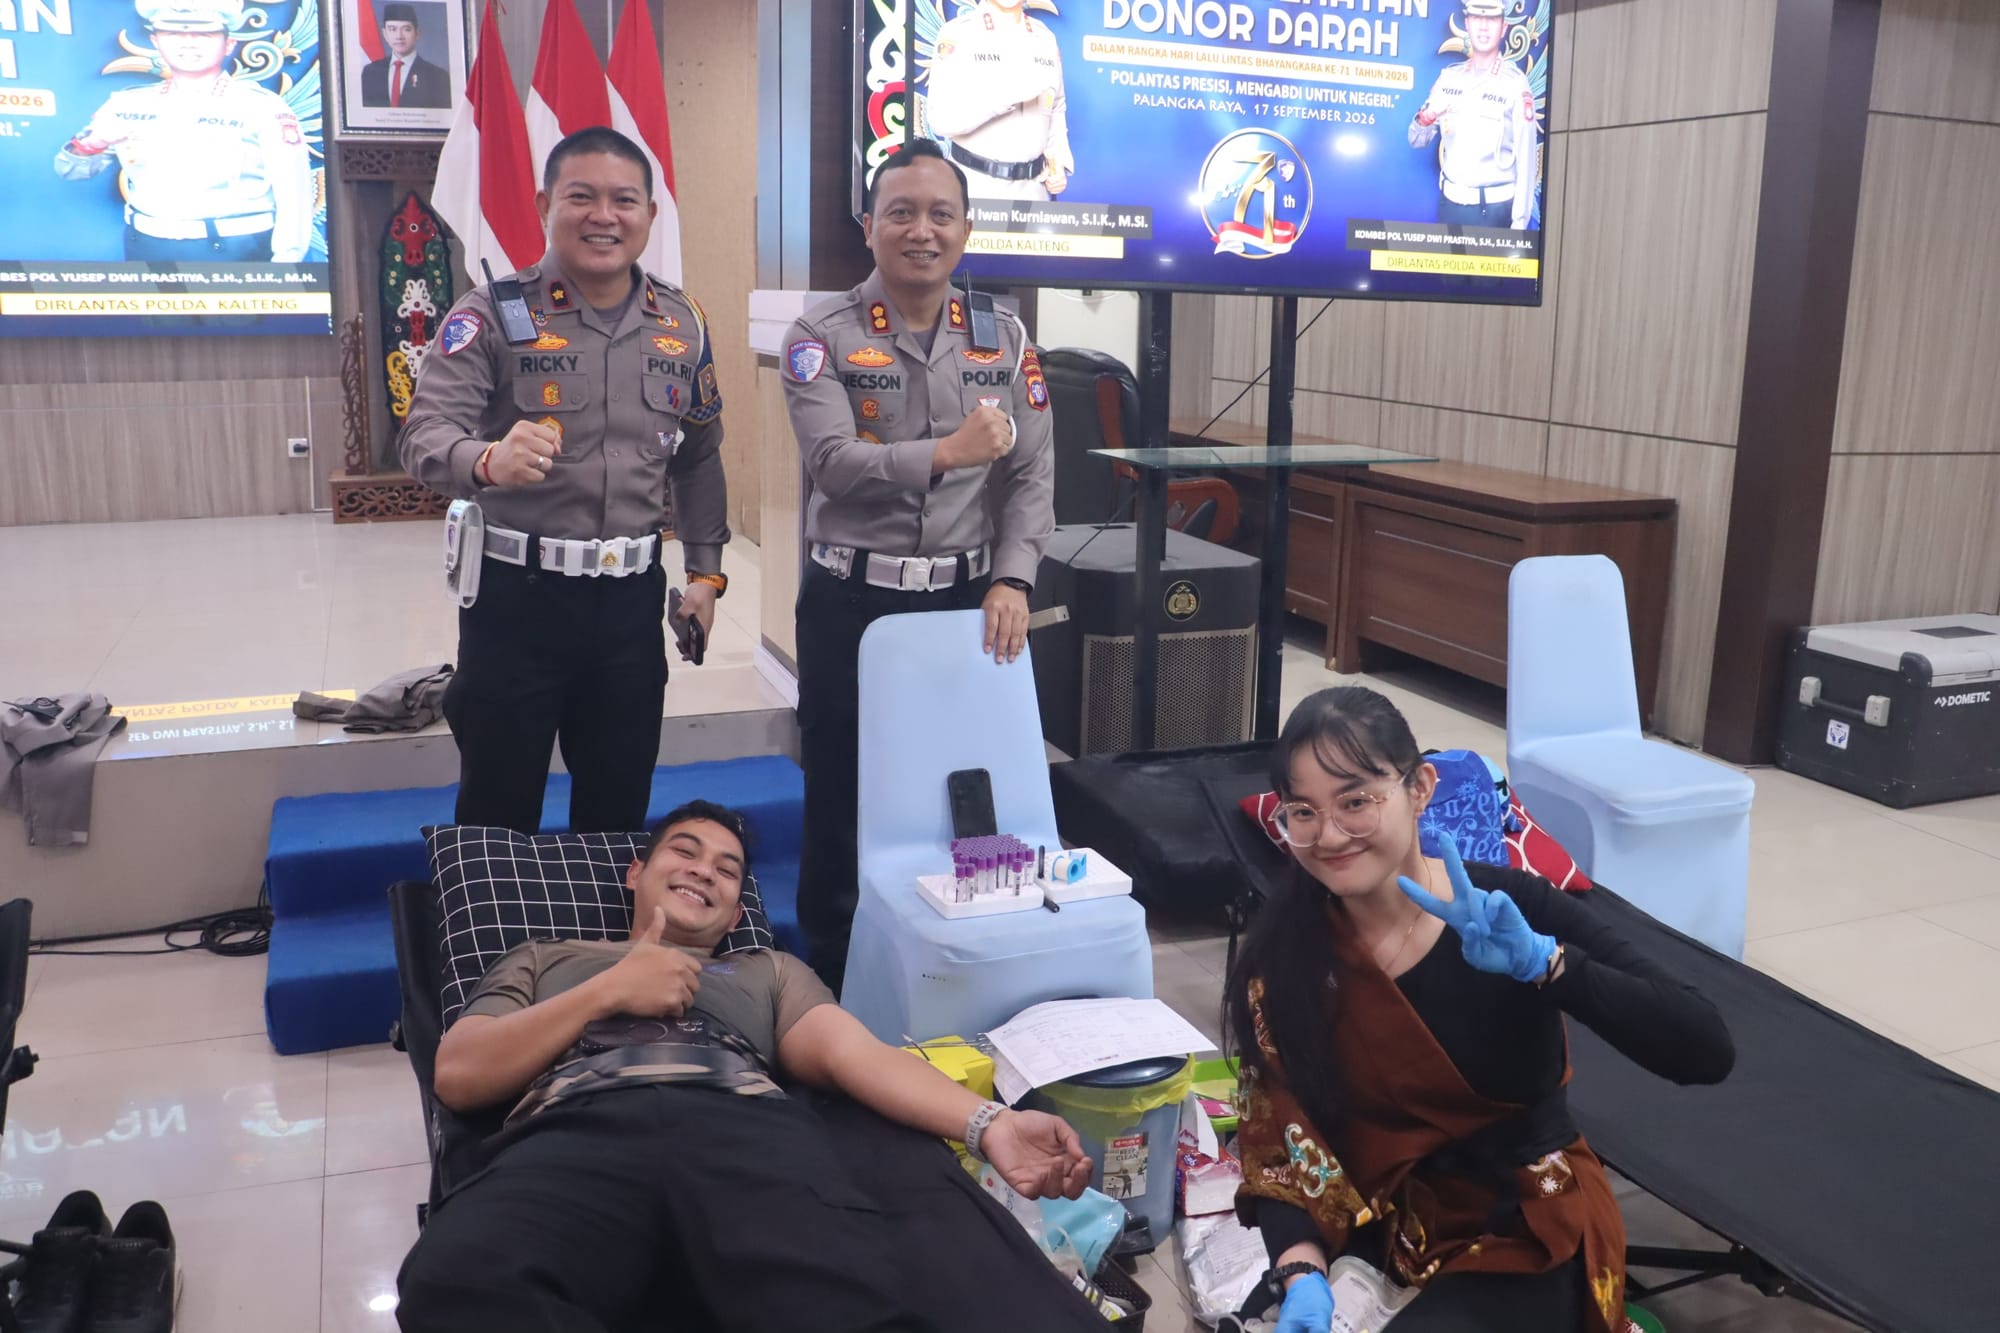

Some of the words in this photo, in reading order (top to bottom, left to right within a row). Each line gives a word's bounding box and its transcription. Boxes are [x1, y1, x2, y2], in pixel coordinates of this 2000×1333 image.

[1103, 0, 1255, 42] DONOR
[1268, 8, 1399, 57] DARAH
[974, 53, 1000, 62] IWAN
[1090, 42, 1125, 54] DALAM
[1128, 47, 1168, 58] RANGKA
[1170, 50, 1193, 61] HARI
[1196, 52, 1219, 63] LALU
[1222, 55, 1253, 67] LINTAS
[1256, 58, 1323, 72] BHAYANGKARA
[1355, 68, 1383, 79] TAHUN
[1385, 70, 1408, 82] 2026
[1111, 69, 1180, 90] POLANTAS
[1183, 76, 1233, 96] PRESISI,
[1236, 80, 1301, 100] MENGABDI
[1305, 87, 1347, 104] UNTUK
[0, 94, 44, 107] 2026
[1134, 93, 1205, 110] PALANGKA
[1209, 99, 1246, 116] RAYA,
[1254, 104, 1269, 115] 17
[1273, 105, 1341, 122] SEPTEMBER
[1345, 112, 1375, 125] 2026
[115, 112, 157, 121] YUSEP
[978, 208, 1008, 222] Iwan
[1011, 210, 1079, 227] Kurniawan,
[1354, 229, 1386, 241] KOMBES
[1387, 231, 1401, 241] POL
[1403, 233, 1425, 242] YUSEP
[1427, 234, 1442, 243] DWI
[965, 237, 1013, 250] APOLDA
[1017, 239, 1070, 253] KALTENG
[1387, 256, 1440, 269] DIRLANTAS
[1443, 259, 1474, 271] POLDA
[1480, 262, 1521, 274] KALTENG
[30, 272, 59, 282] POL
[61, 272, 106, 282] YUSEP
[109, 272, 138, 282] DWI
[35, 299, 139, 311] DIRLANTAS
[146, 299, 207, 311] POLDA
[218, 299, 297, 311] KALTENG
[520, 355, 579, 373] RICKY
[647, 359, 692, 381] POLRI
[843, 373, 900, 390] JECSON
[962, 370, 1010, 387] POLRI
[1948, 691, 1991, 706] DOMETIC
